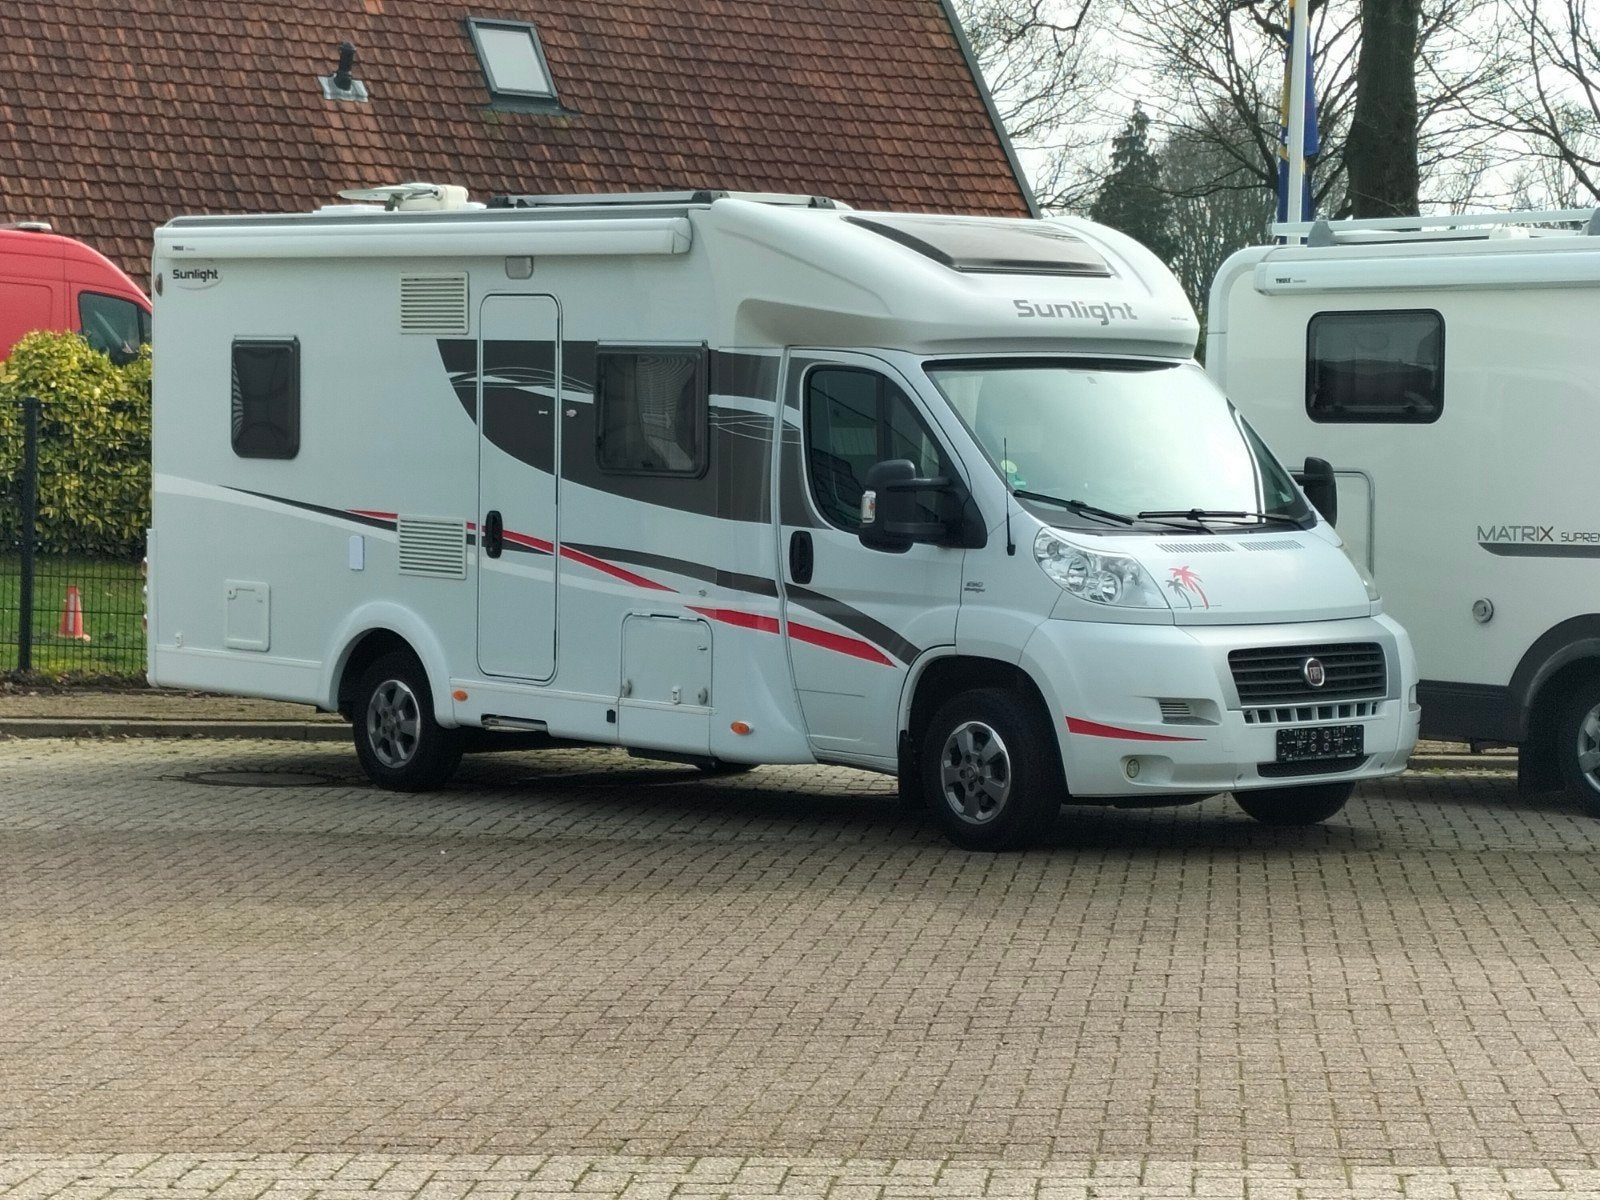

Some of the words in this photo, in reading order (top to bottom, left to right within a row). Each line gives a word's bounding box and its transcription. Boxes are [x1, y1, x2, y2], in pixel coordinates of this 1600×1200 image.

[172, 269, 218, 282] Sunlight
[1013, 299, 1138, 326] Sunlight
[1477, 525, 1554, 542] MATRIX
[1560, 532, 1600, 542] SUPRE
